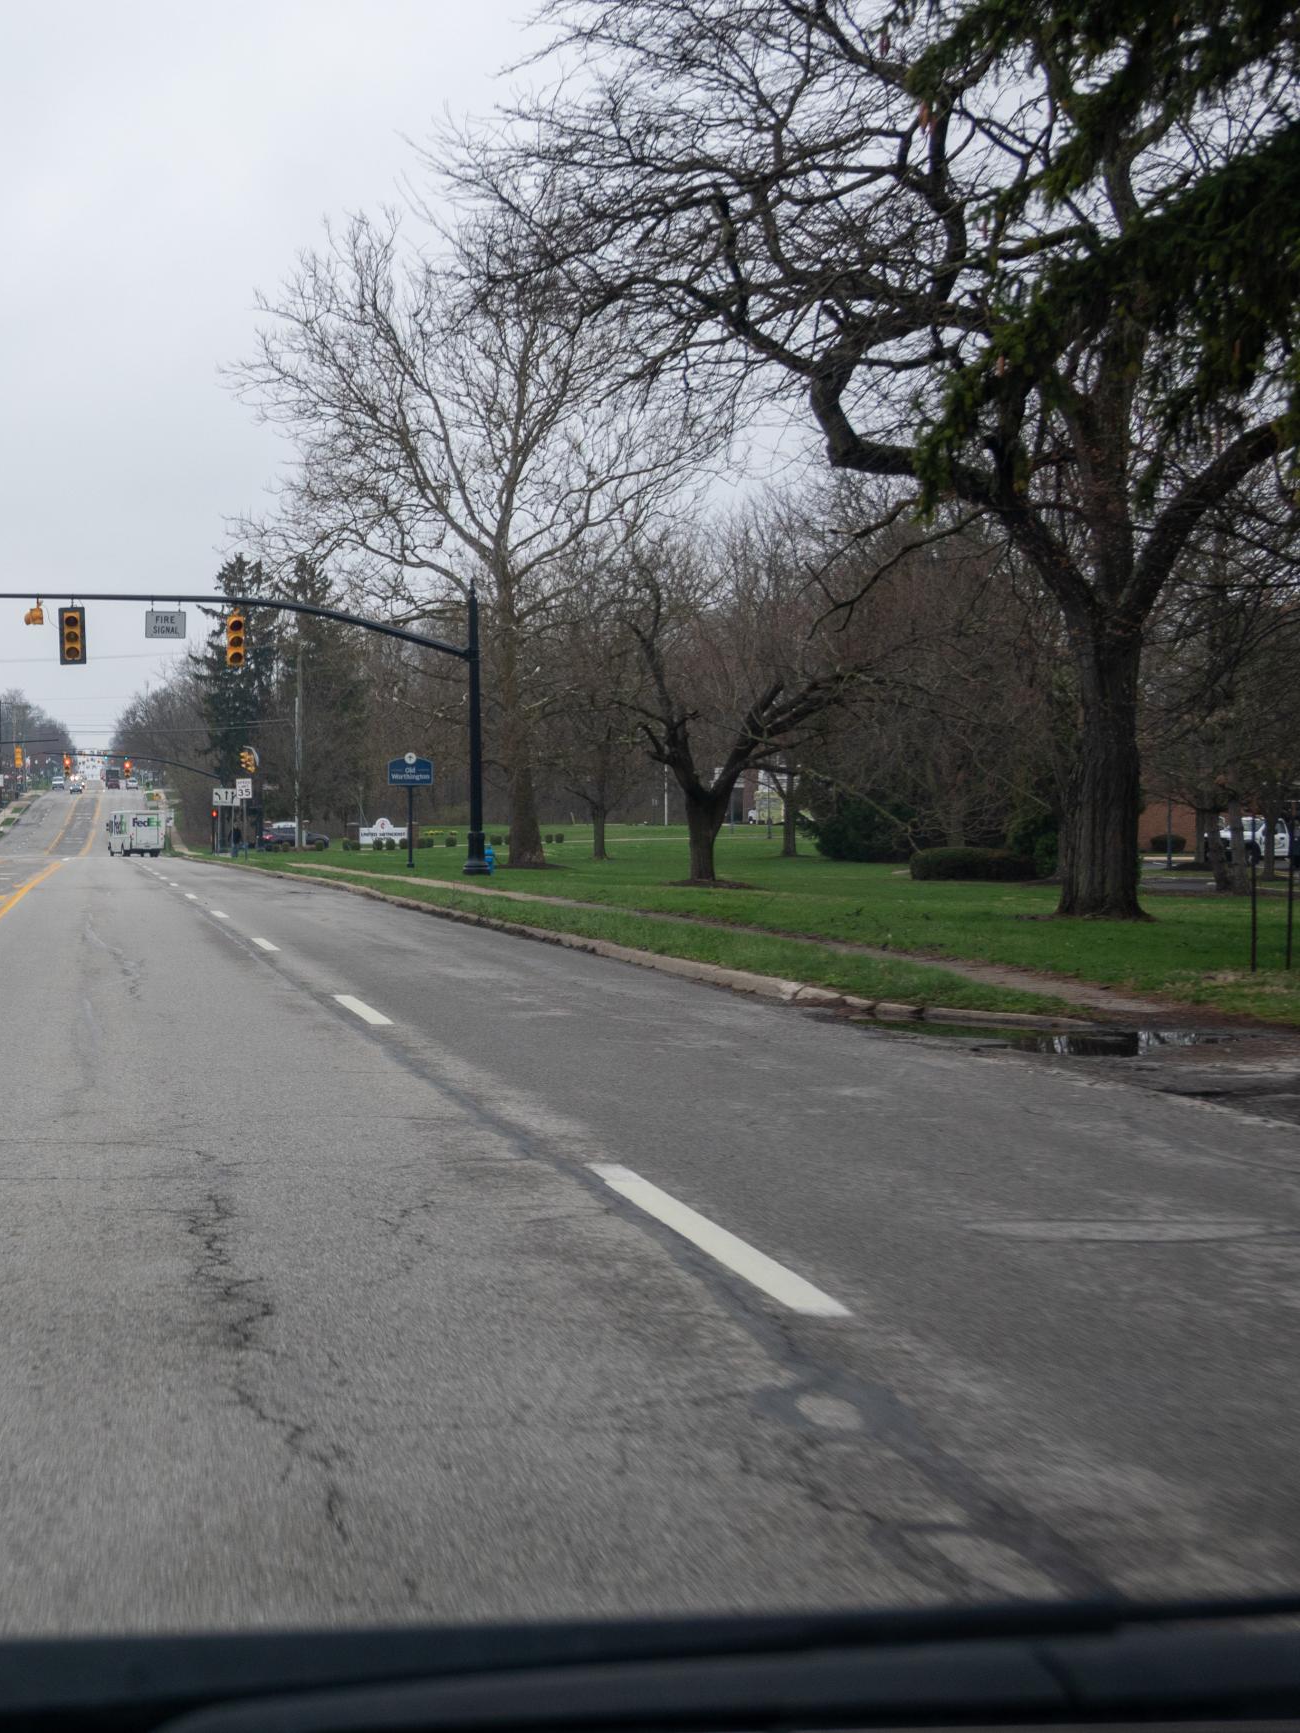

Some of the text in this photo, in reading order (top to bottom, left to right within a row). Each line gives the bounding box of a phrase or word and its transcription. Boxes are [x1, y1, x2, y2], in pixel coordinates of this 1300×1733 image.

[155, 615, 175, 624] FIRE
[153, 625, 179, 634] SIGNAL
[238, 788, 251, 797] 35
[132, 817, 161, 828] FedEx
